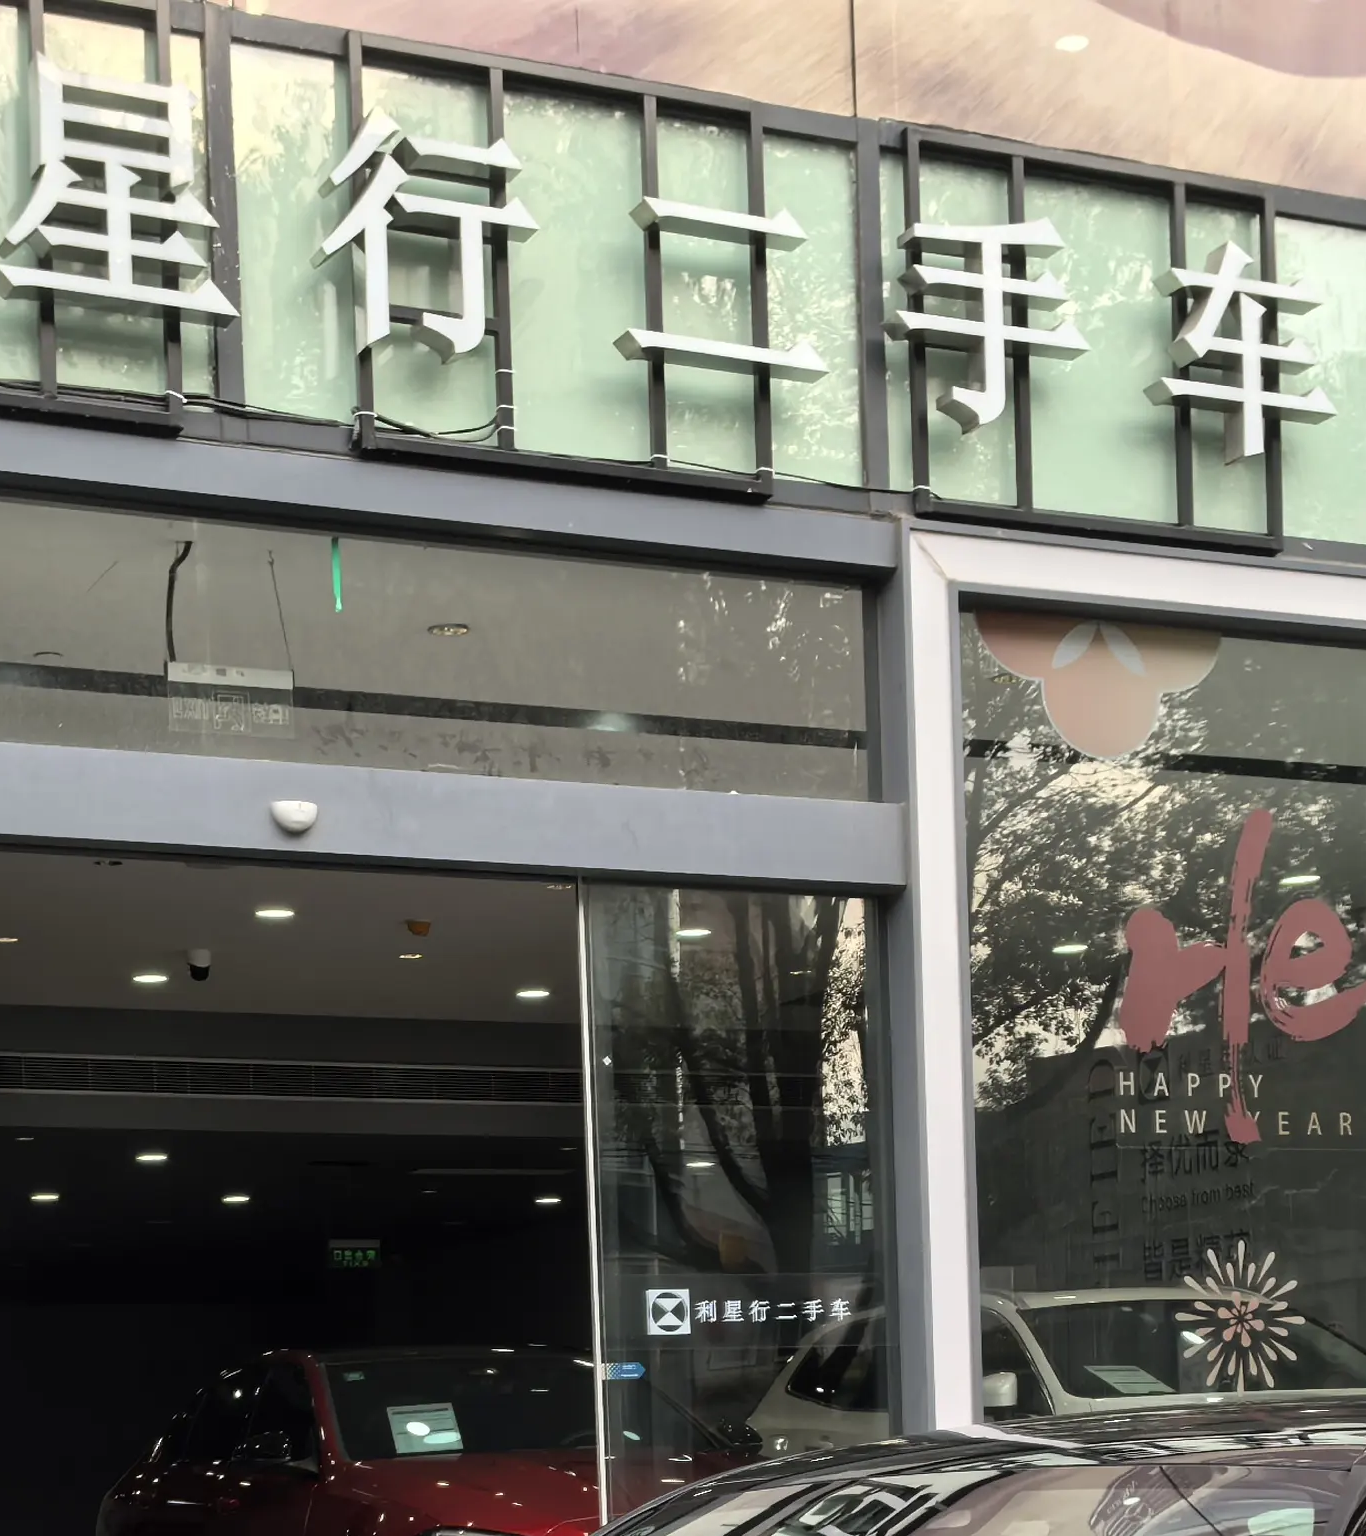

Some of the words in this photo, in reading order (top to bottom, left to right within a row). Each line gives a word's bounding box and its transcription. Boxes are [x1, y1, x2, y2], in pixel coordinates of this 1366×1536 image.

[1119, 1072, 1264, 1098] HAPPY
[1120, 1108, 1208, 1134] NEW
[1191, 1187, 1221, 1206] from
[694, 1298, 852, 1323] 利星行二手车
